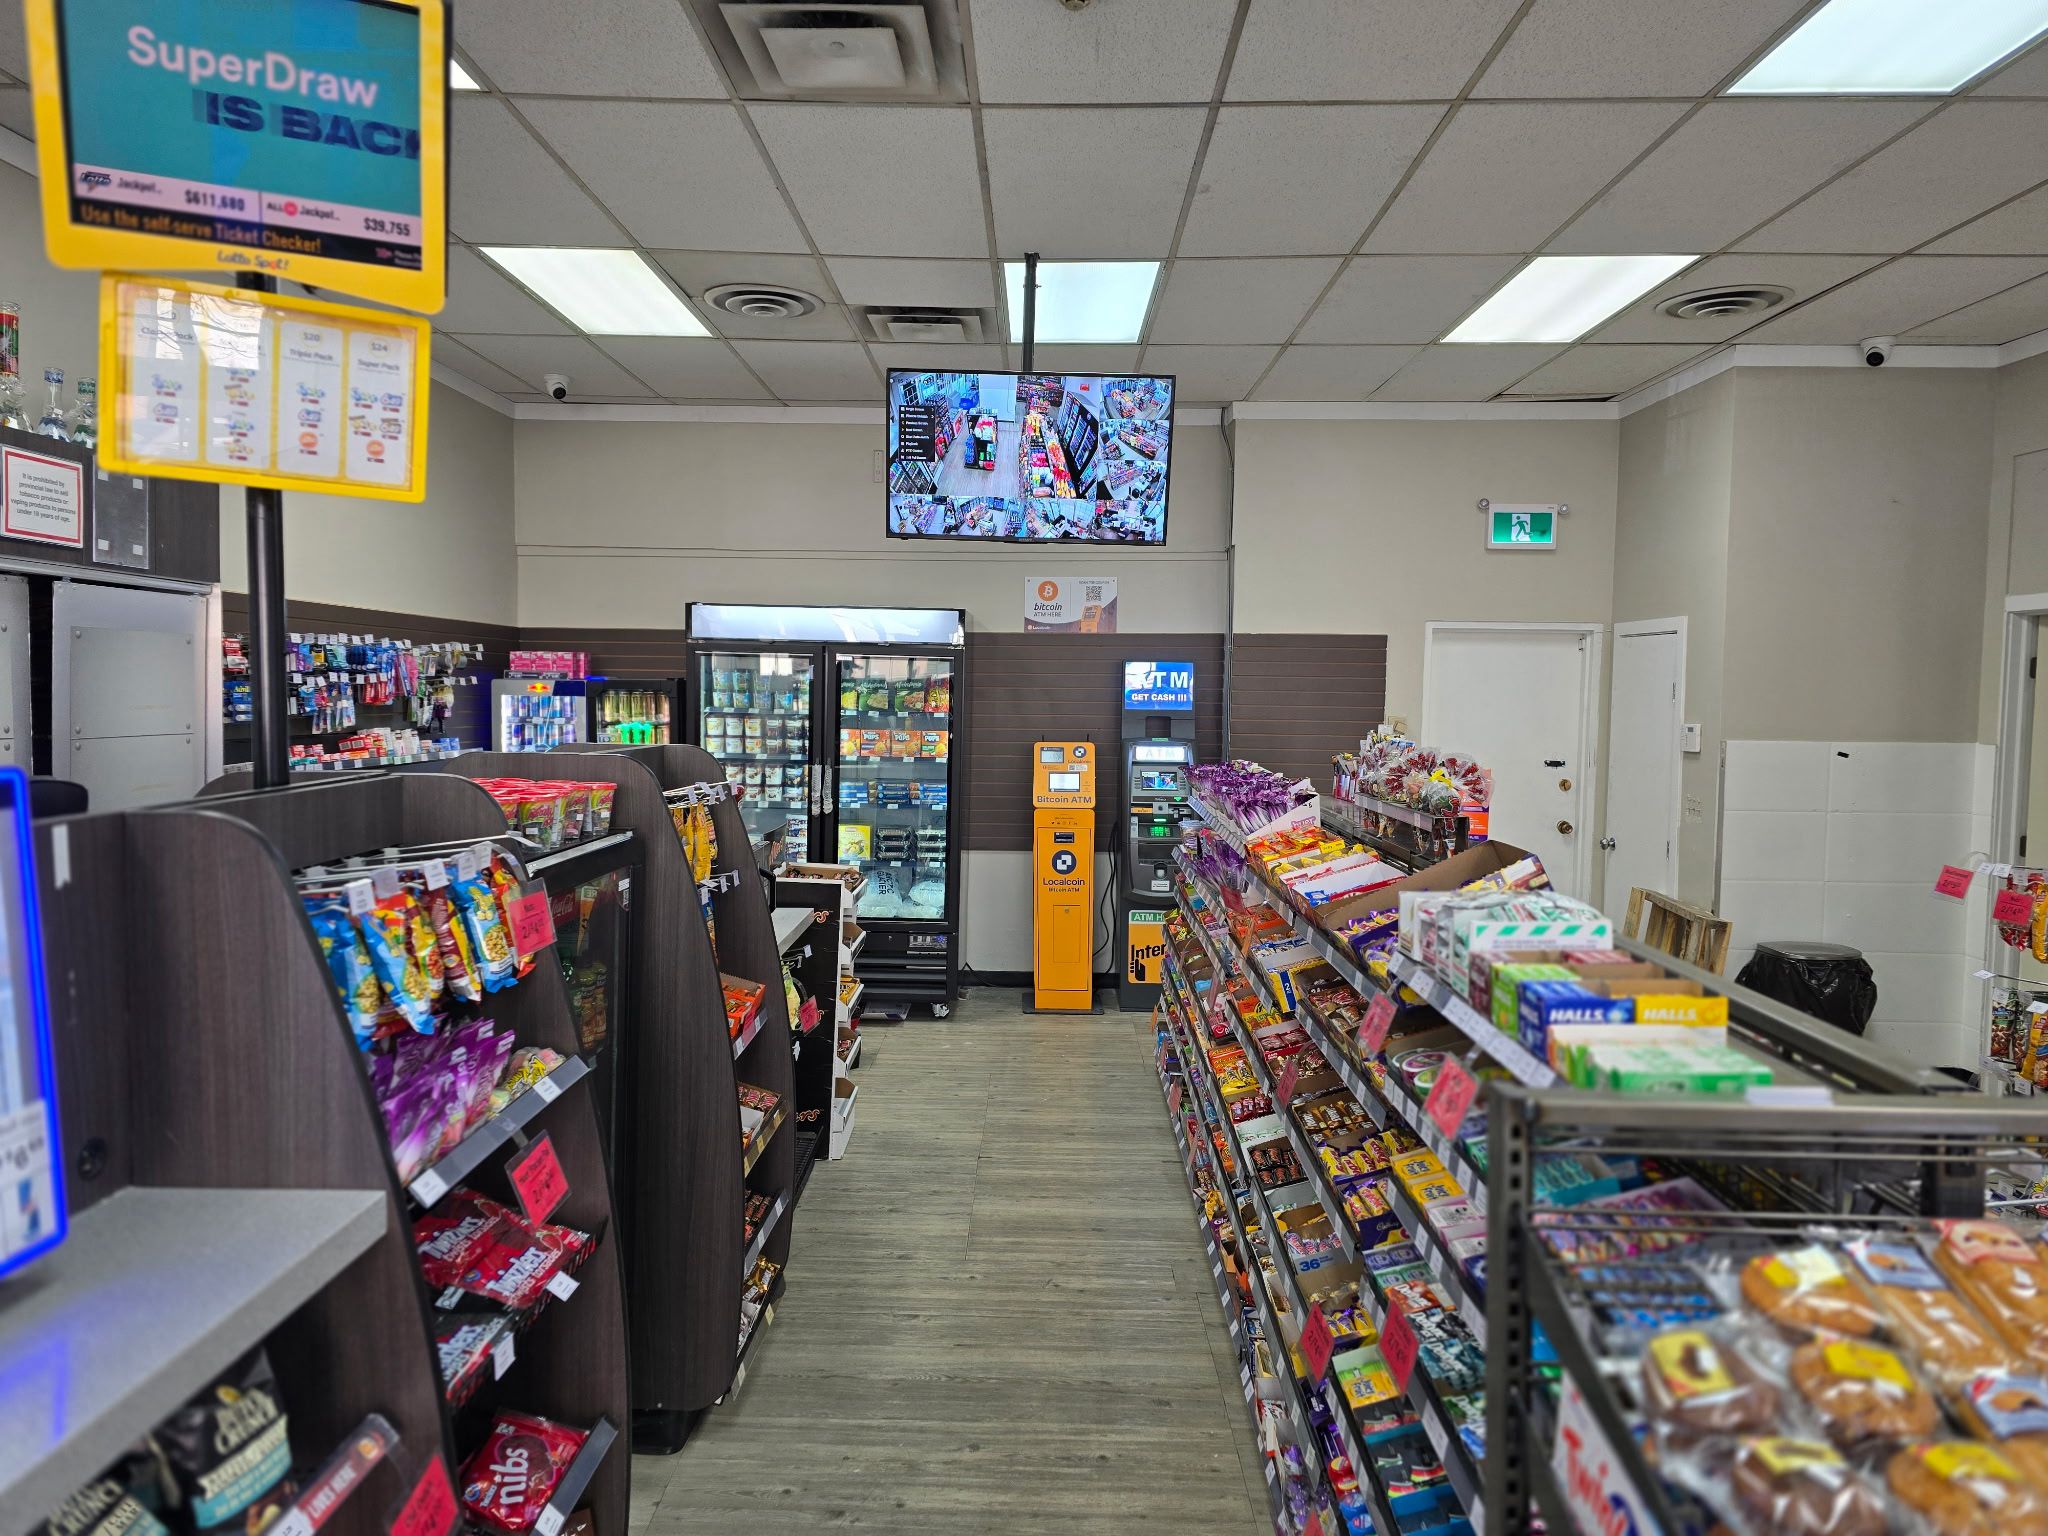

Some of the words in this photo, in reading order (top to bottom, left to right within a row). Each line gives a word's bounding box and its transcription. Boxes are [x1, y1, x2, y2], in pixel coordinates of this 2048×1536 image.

[127, 25, 379, 107] SuperDraw
[205, 92, 265, 132] IS
[80, 204, 111, 224] Use
[114, 209, 139, 229] the
[215, 223, 260, 245] Ticket
[263, 230, 322, 254] Checker!
[363, 217, 411, 236] $39,755
[217, 250, 251, 265] Lotto
[33, 475, 59, 485] prohibited
[19, 482, 44, 492] provincial
[19, 490, 40, 500] tobacco
[41, 495, 62, 505] products
[17, 508, 32, 516] under
[29, 501, 53, 511] products
[1034, 602, 1063, 611] bitcoin
[1131, 693, 1149, 702] GET
[1151, 693, 1175, 702] CASH
[1037, 795, 1069, 803] Bitcoin
[1071, 796, 1092, 804] ATM
[1042, 878, 1086, 886] Localcoin
[1133, 913, 1154, 921] ATM
[1550, 1008, 1603, 1021] HALLS
[1643, 1008, 1698, 1021] HALLS
[485, 1246, 548, 1296] Twizzlers
[1300, 1257, 1321, 1272] 36
[489, 1447, 529, 1505] nibs
